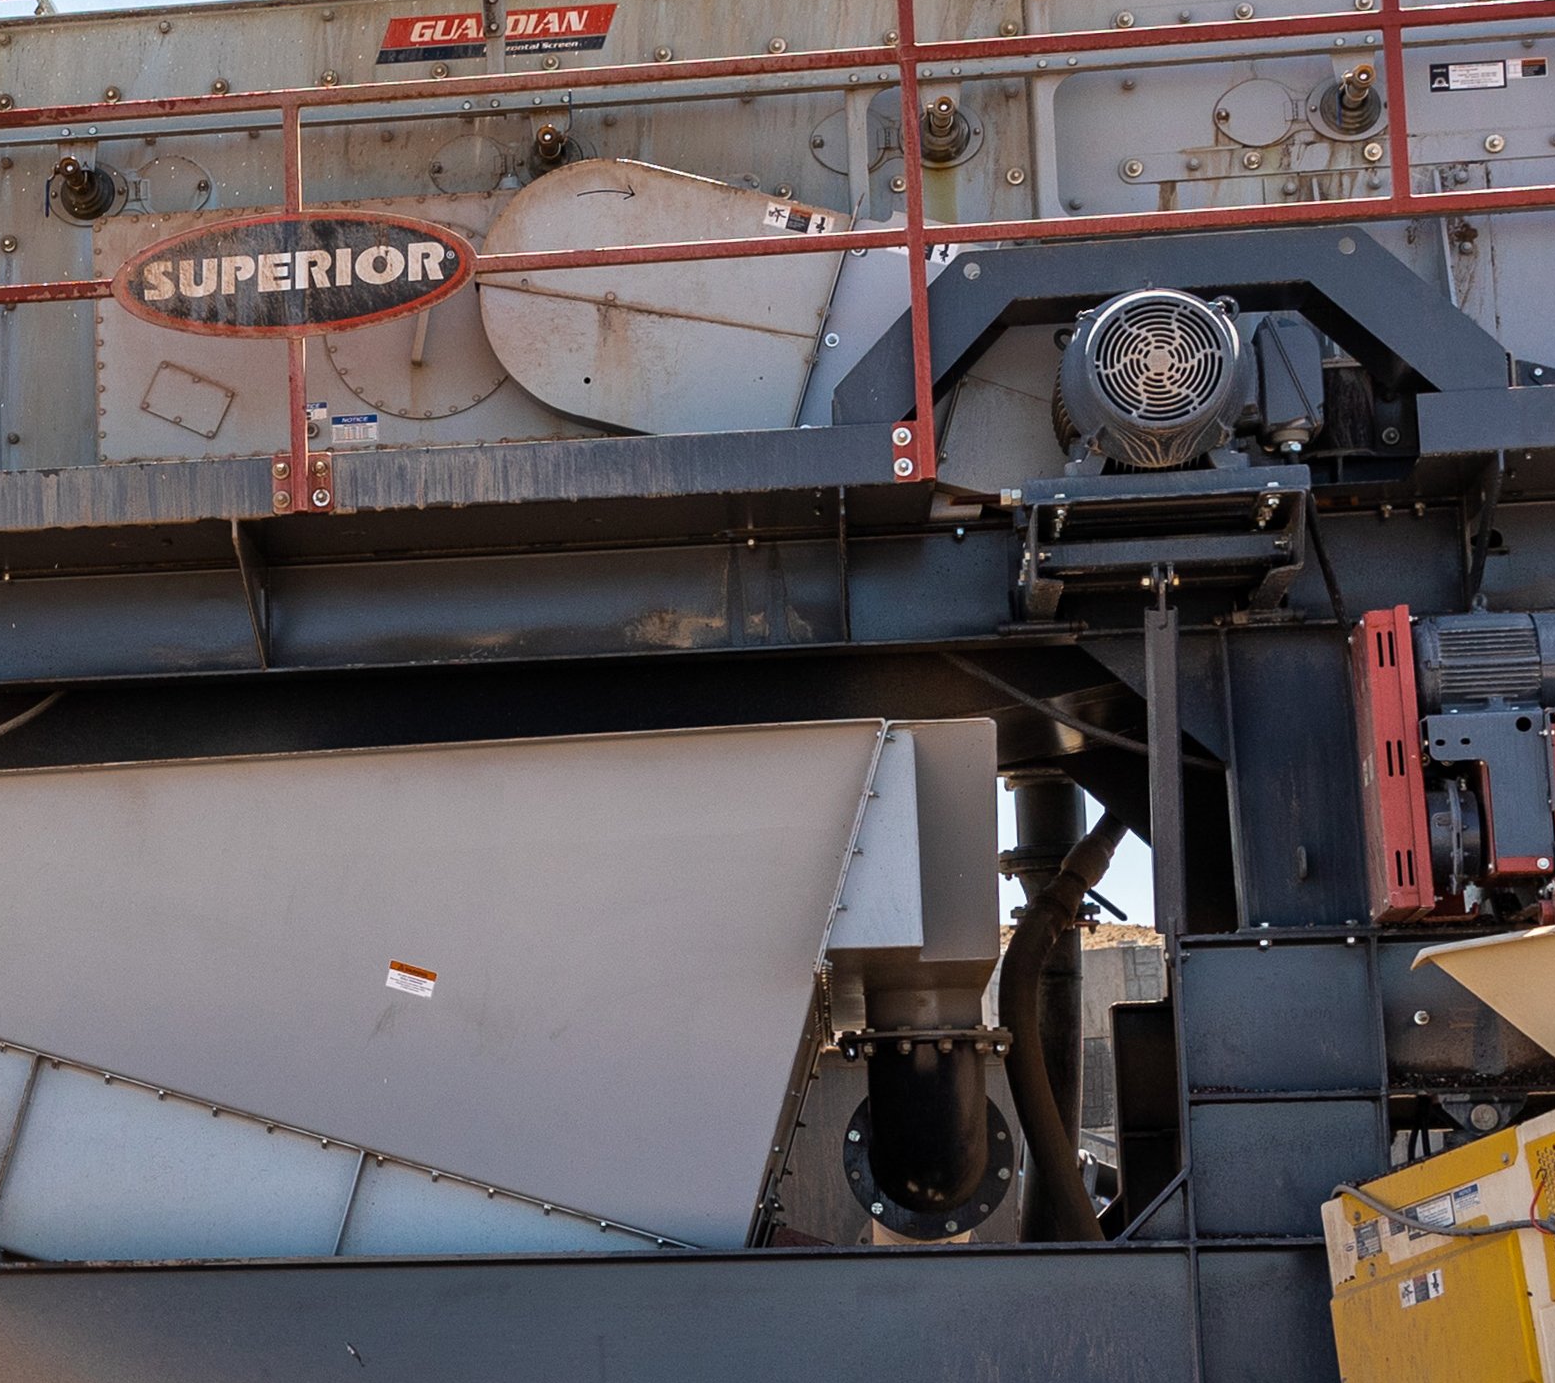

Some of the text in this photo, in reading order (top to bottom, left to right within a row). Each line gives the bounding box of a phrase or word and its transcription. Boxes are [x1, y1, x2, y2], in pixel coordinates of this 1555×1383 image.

[410, 10, 589, 43] GUADIAN
[483, 40, 578, 54] zontal Screen
